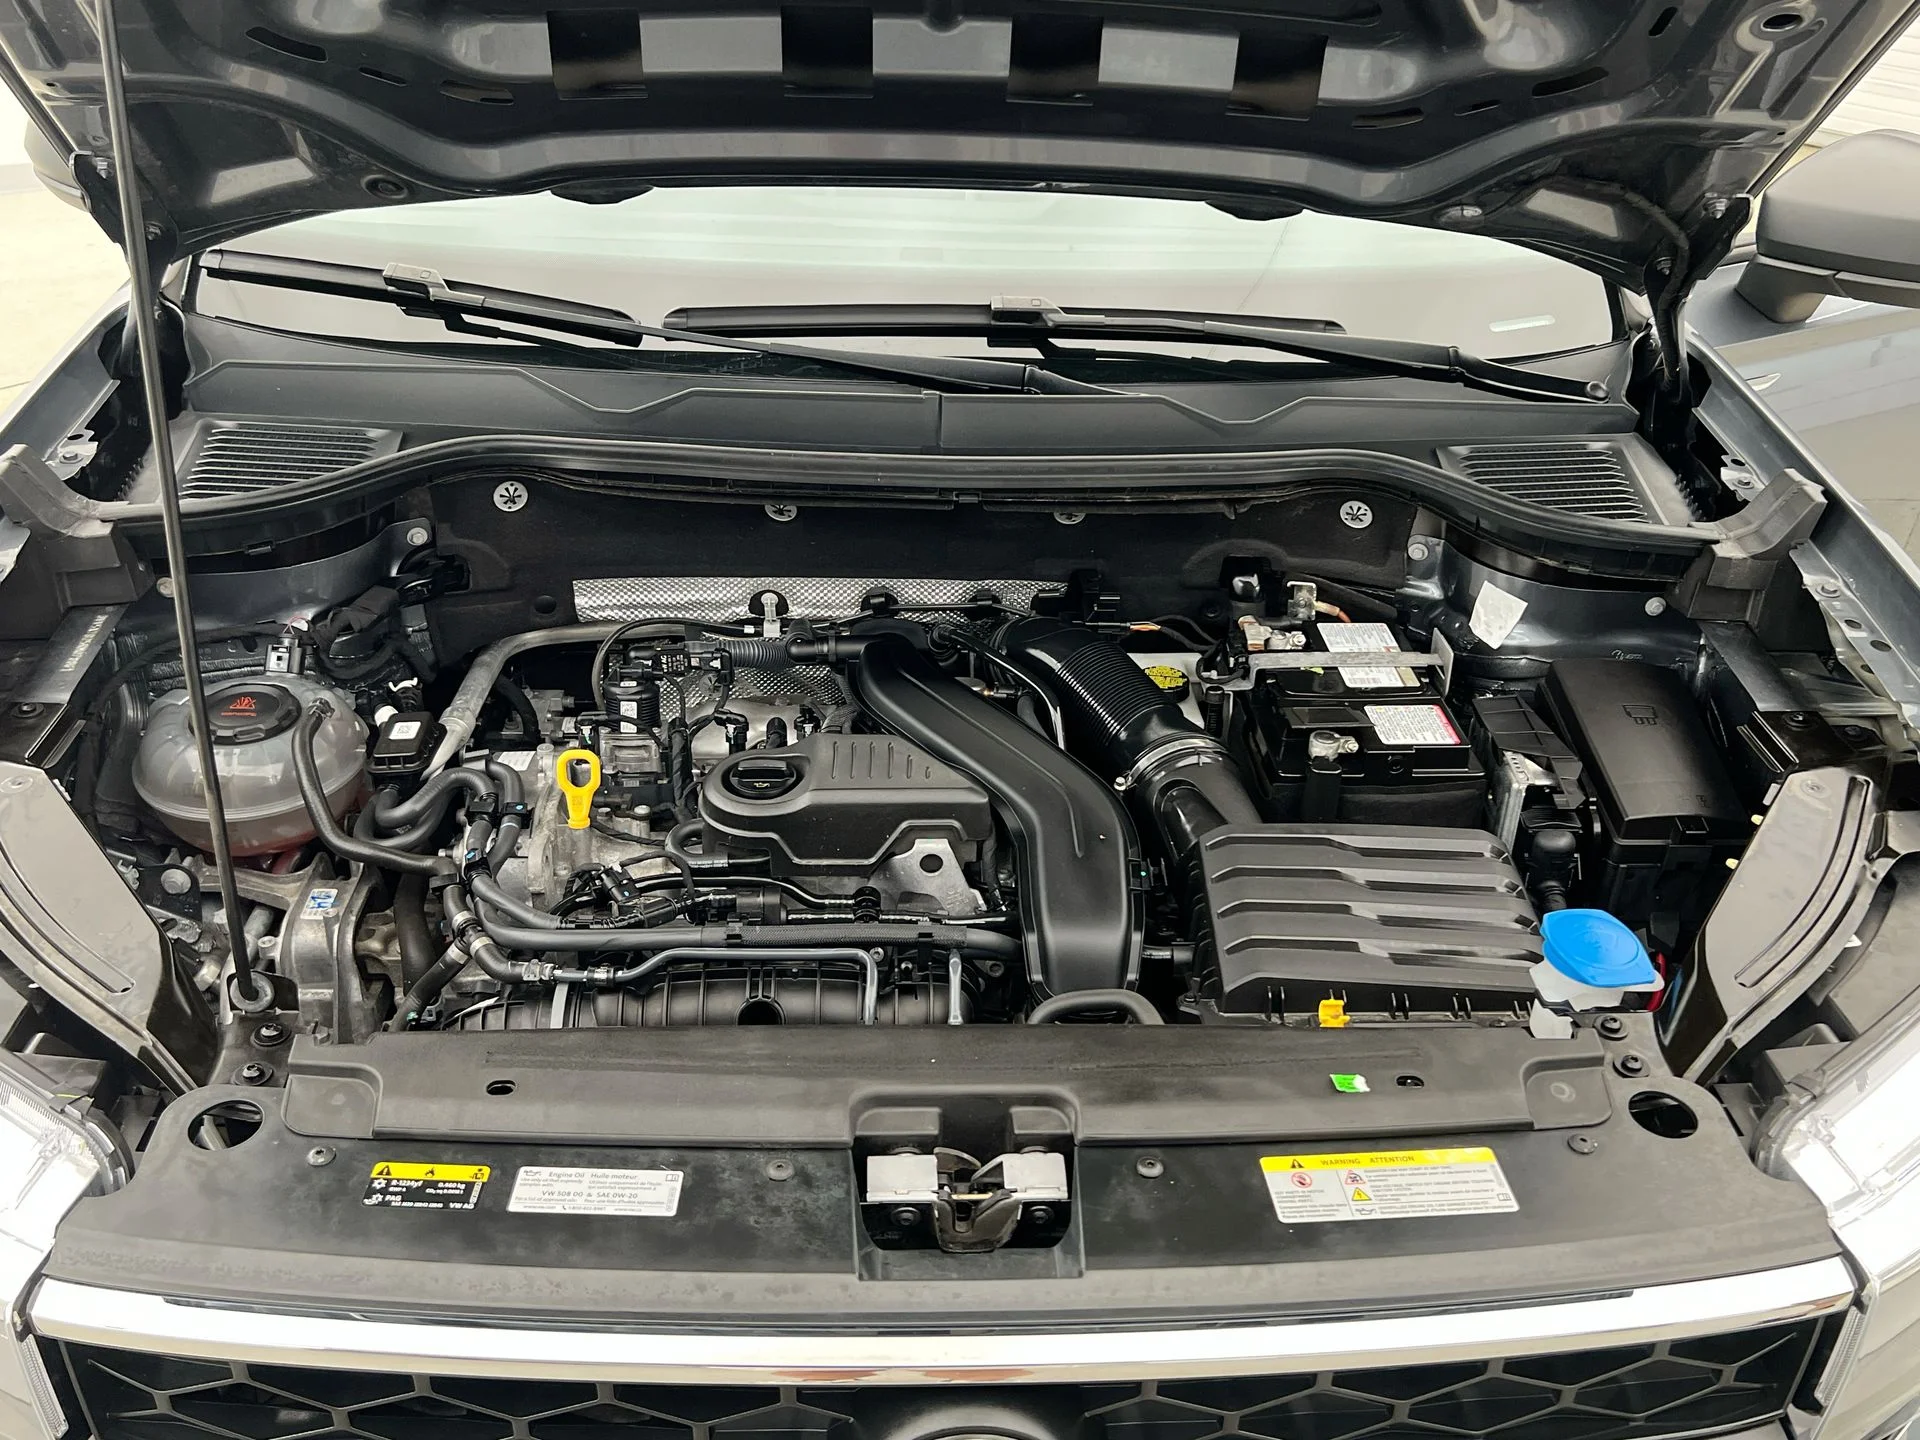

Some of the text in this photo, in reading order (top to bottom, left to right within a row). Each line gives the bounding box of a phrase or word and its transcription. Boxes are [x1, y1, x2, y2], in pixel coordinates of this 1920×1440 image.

[1320, 1155, 1415, 1166] WARNING ATTENTION
[548, 1171, 573, 1179] Engine
